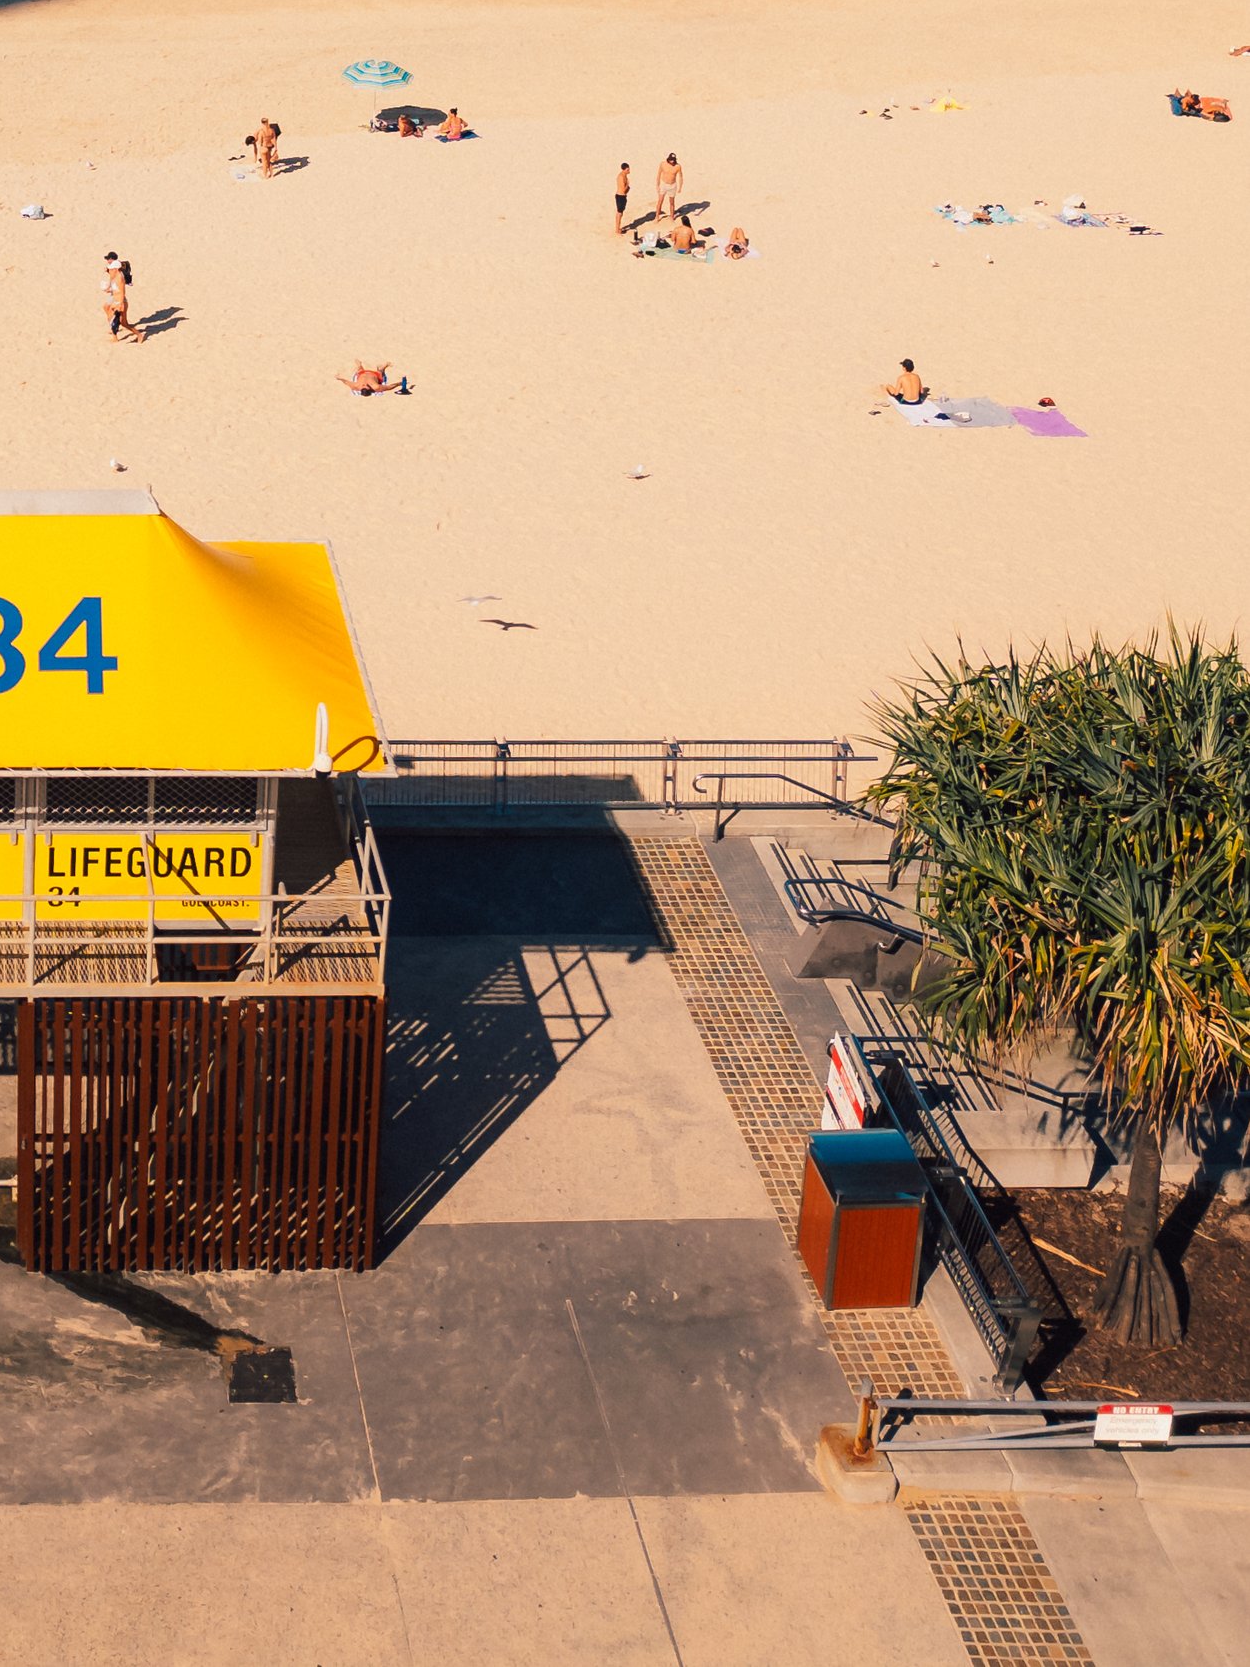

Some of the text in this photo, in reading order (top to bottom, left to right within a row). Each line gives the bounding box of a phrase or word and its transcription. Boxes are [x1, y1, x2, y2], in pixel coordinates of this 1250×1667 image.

[48, 847, 251, 878] LIFEGUARD
[48, 886, 81, 907] 34
[1112, 1406, 1160, 1414] NO ENTRY
